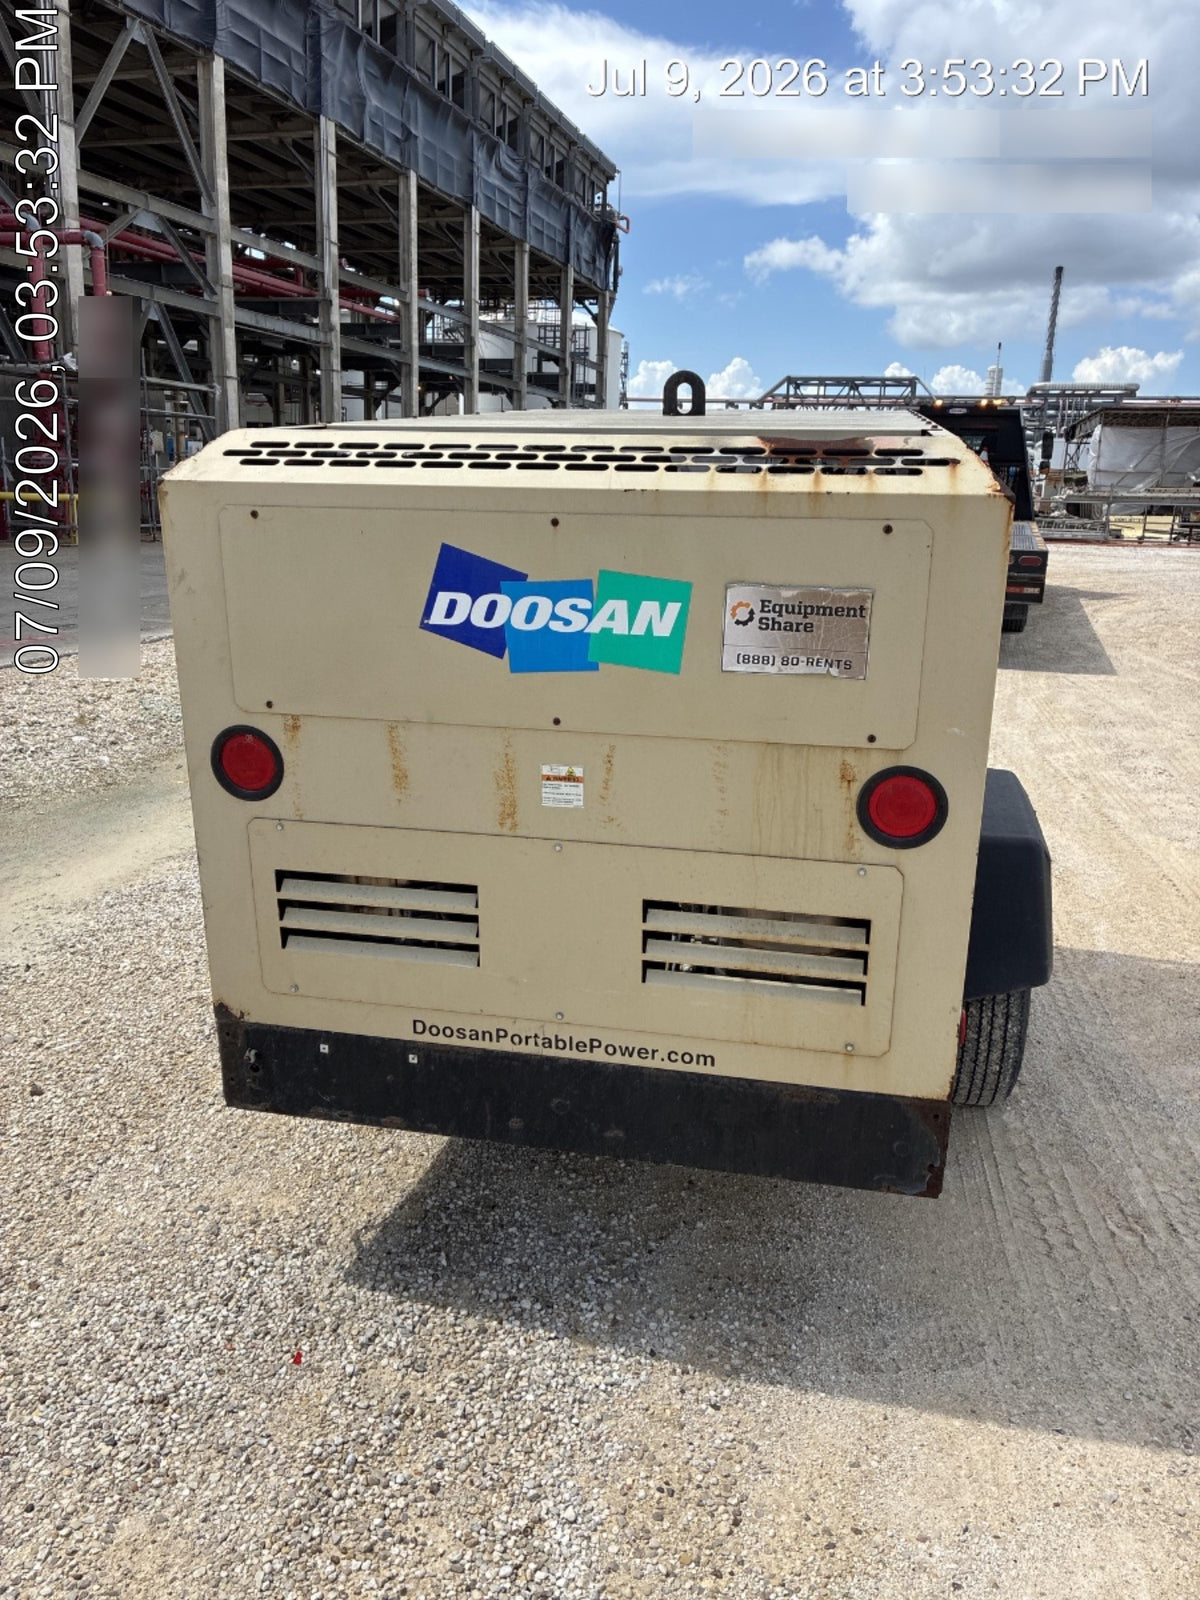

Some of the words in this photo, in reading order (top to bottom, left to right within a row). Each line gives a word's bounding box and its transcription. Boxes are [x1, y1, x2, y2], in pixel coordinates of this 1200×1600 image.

[429, 591, 682, 637] DOOSAN
[760, 599, 867, 619] Equipment
[758, 617, 815, 632] Share
[736, 653, 776, 667] (888)
[781, 656, 853, 670] 80-RENTS
[412, 1019, 715, 1067] DoosanPortablePower.com
